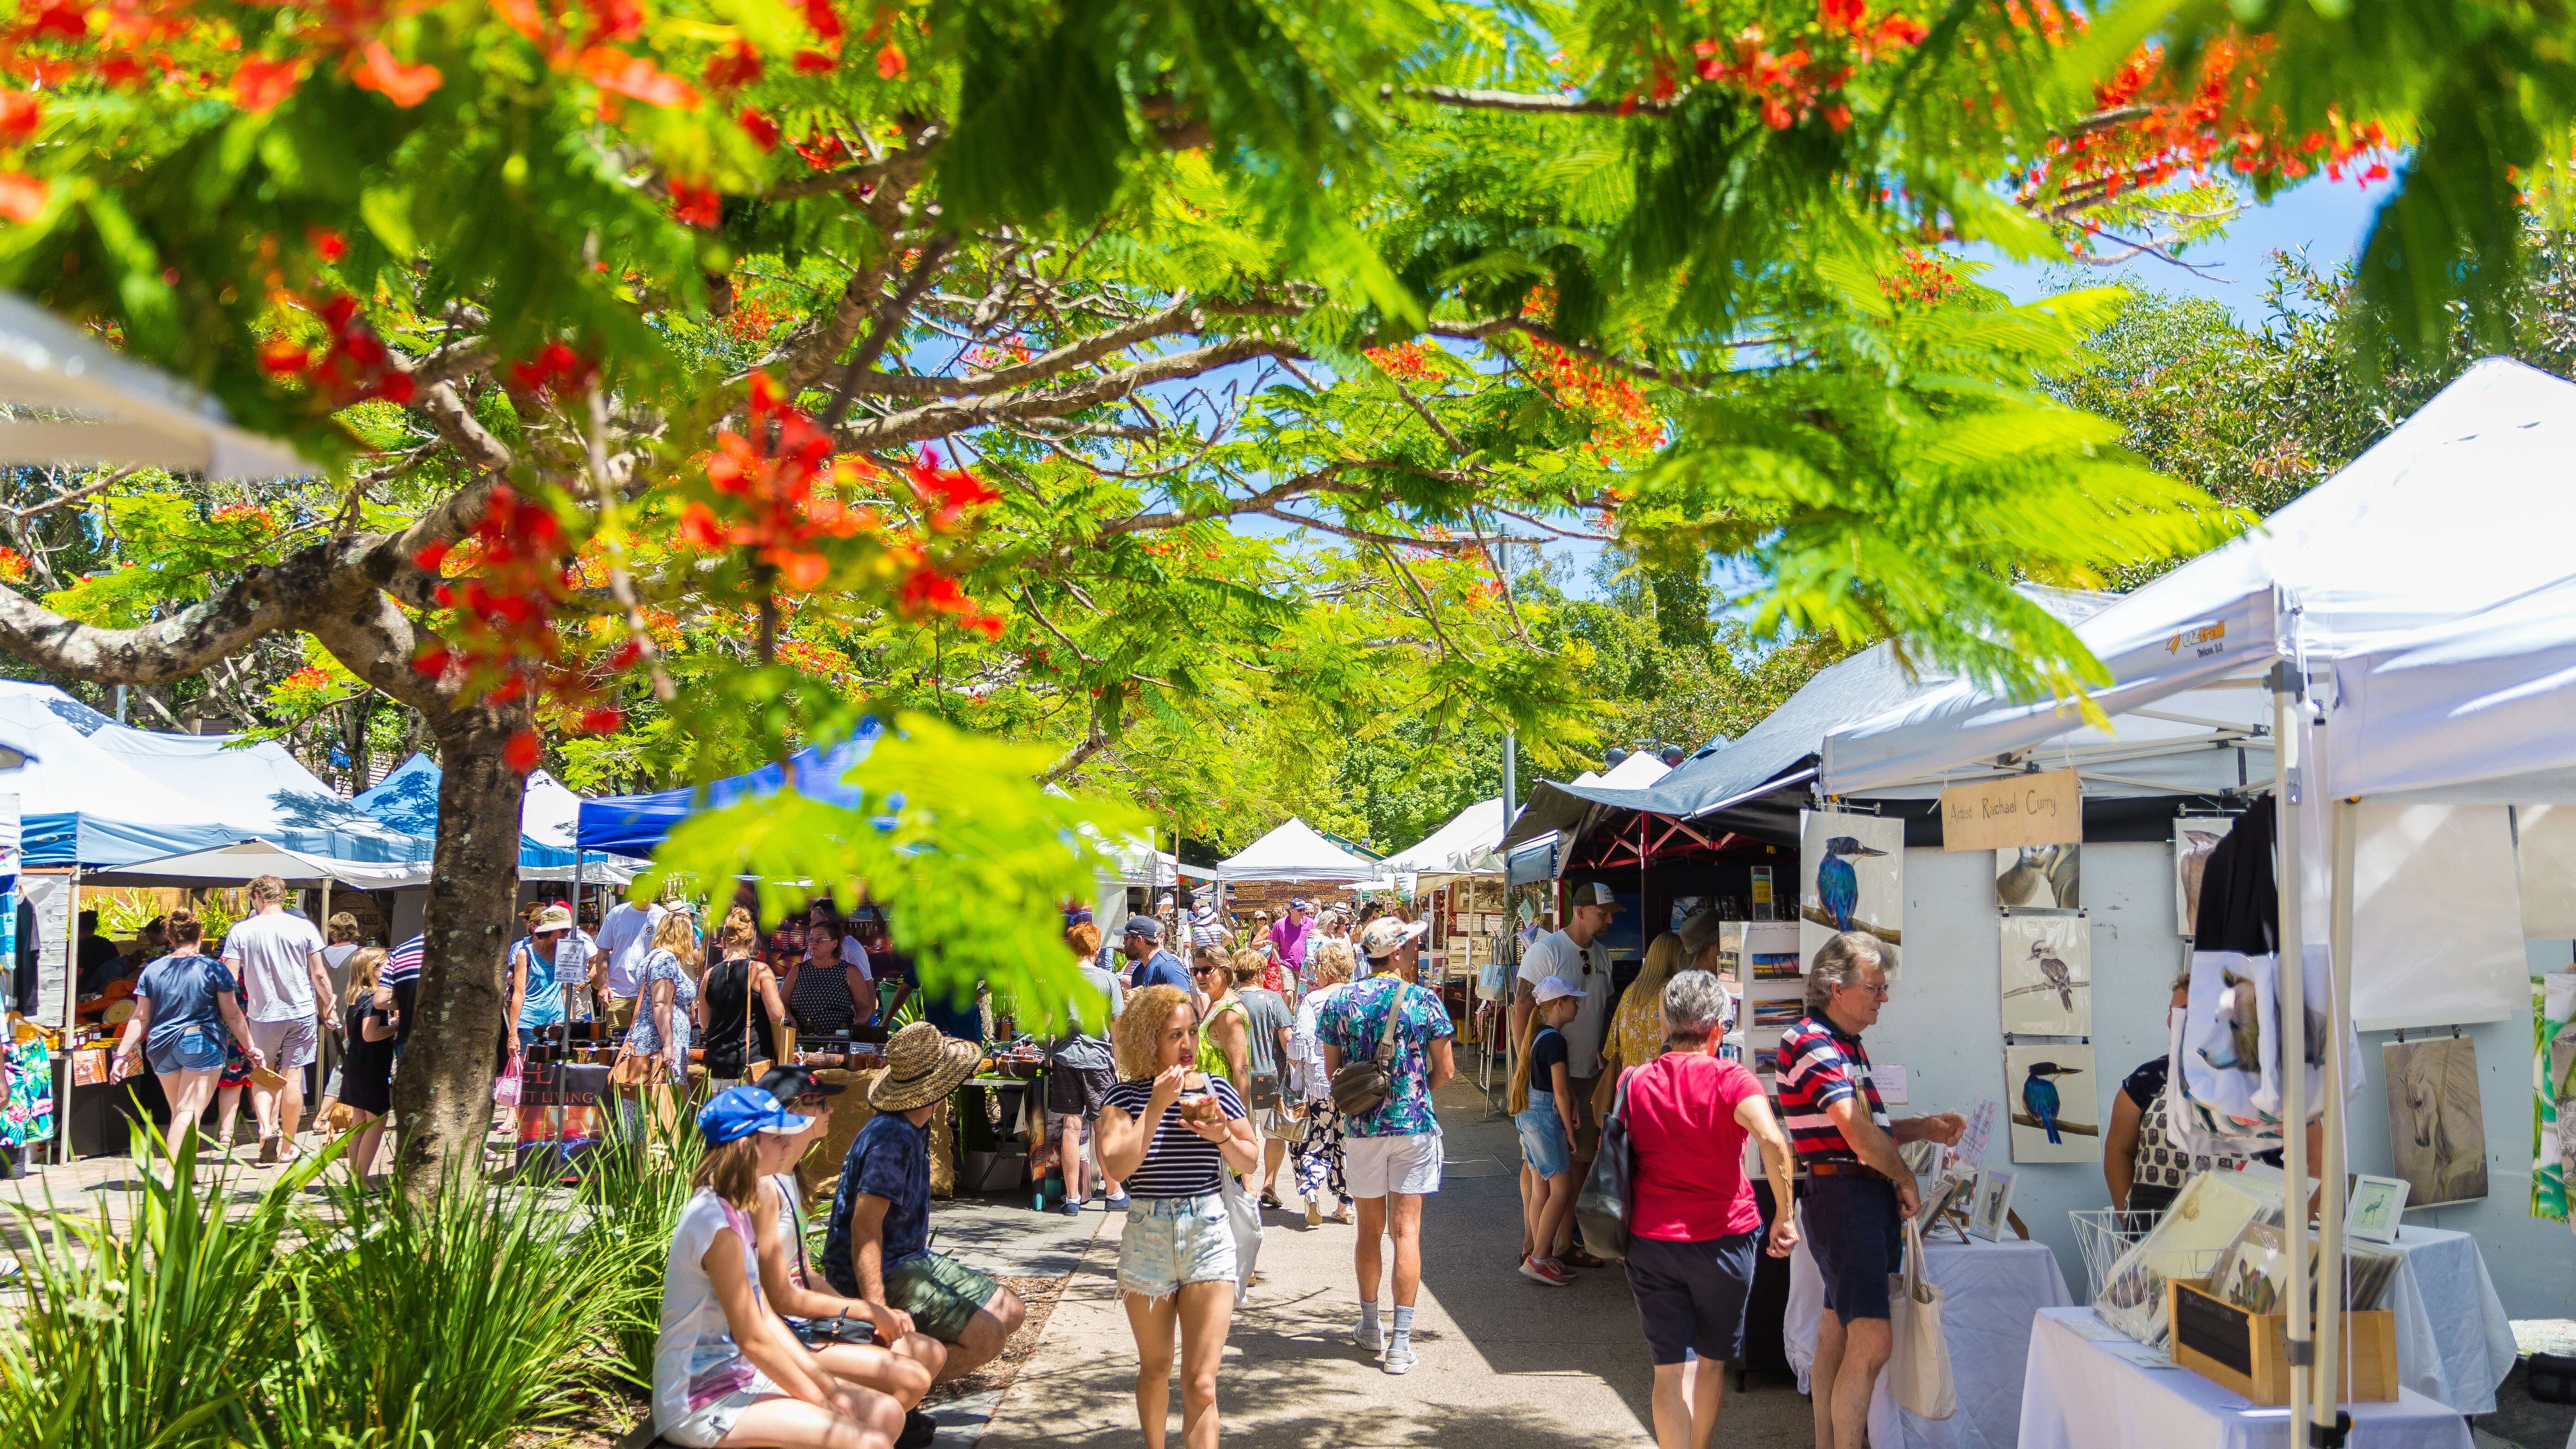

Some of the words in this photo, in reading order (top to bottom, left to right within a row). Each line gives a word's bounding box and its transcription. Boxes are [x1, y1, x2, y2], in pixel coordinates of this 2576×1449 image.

[2196, 646, 2214, 658] Deluxe
[2214, 642, 2223, 654] 3.0
[1949, 803, 1973, 825] Artist
[1982, 792, 2017, 820] Rachael
[2026, 789, 2057, 817] Curry
[541, 1091, 593, 1104] LIVING
